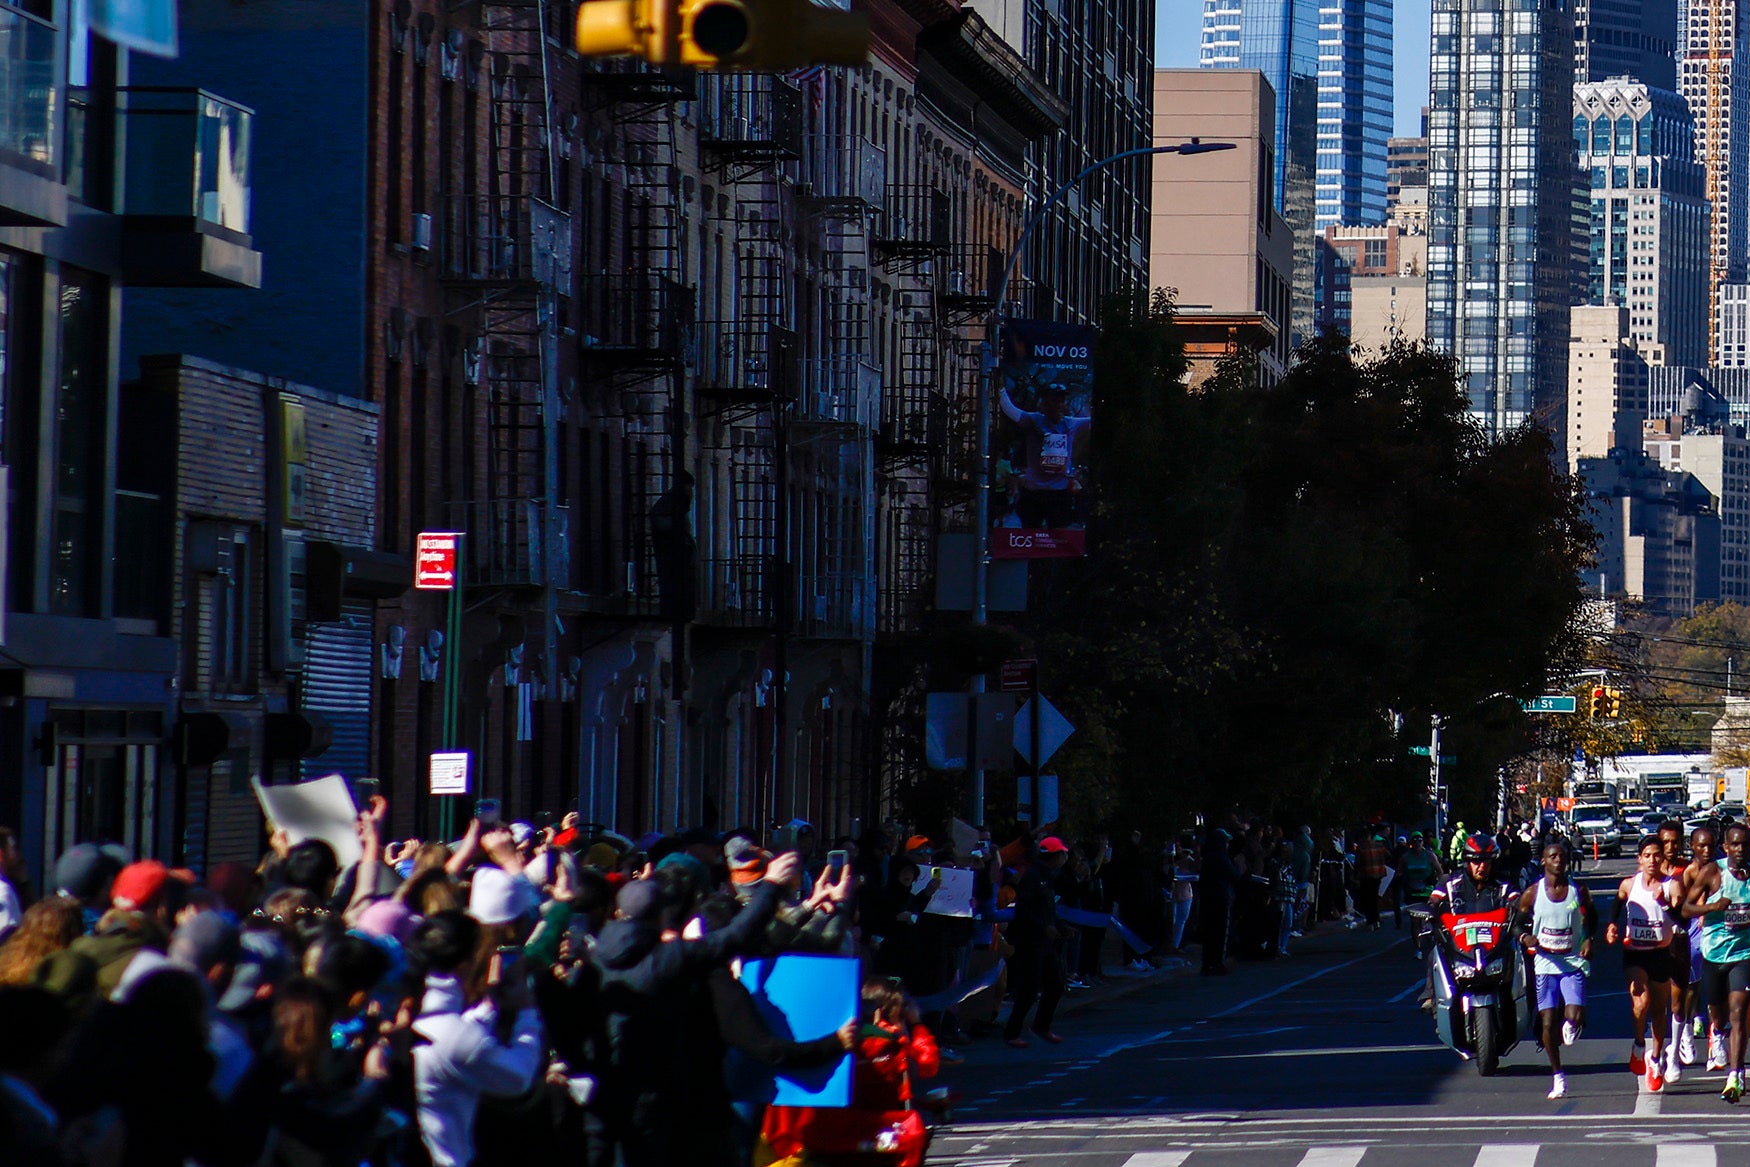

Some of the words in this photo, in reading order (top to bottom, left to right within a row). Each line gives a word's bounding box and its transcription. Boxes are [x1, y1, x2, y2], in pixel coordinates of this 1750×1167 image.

[1034, 345, 1066, 357] NOV
[1069, 346, 1088, 358] 03
[1010, 533, 1033, 547] tcs
[1541, 699, 1553, 708] St
[1634, 928, 1658, 939] LARA
